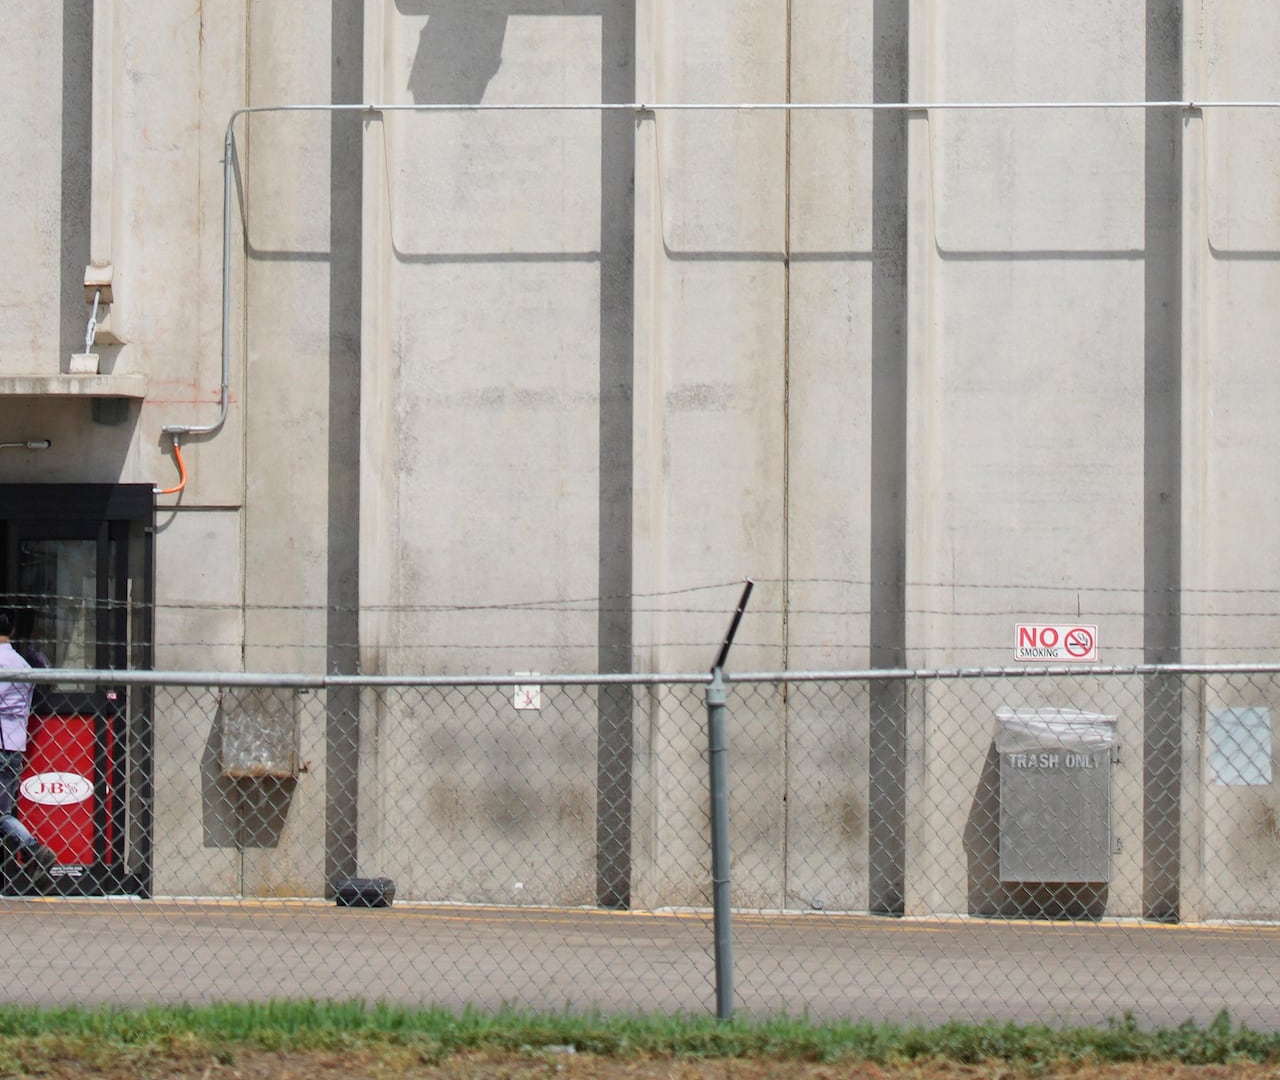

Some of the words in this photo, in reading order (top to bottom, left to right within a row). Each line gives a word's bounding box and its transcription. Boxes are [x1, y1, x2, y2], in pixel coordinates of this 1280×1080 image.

[1019, 626, 1059, 648] NO
[1019, 648, 1059, 658] SMOKING
[1009, 753, 1059, 769] TRASH
[1065, 753, 1100, 769] ONLY
[34, 781, 79, 795] JBS
